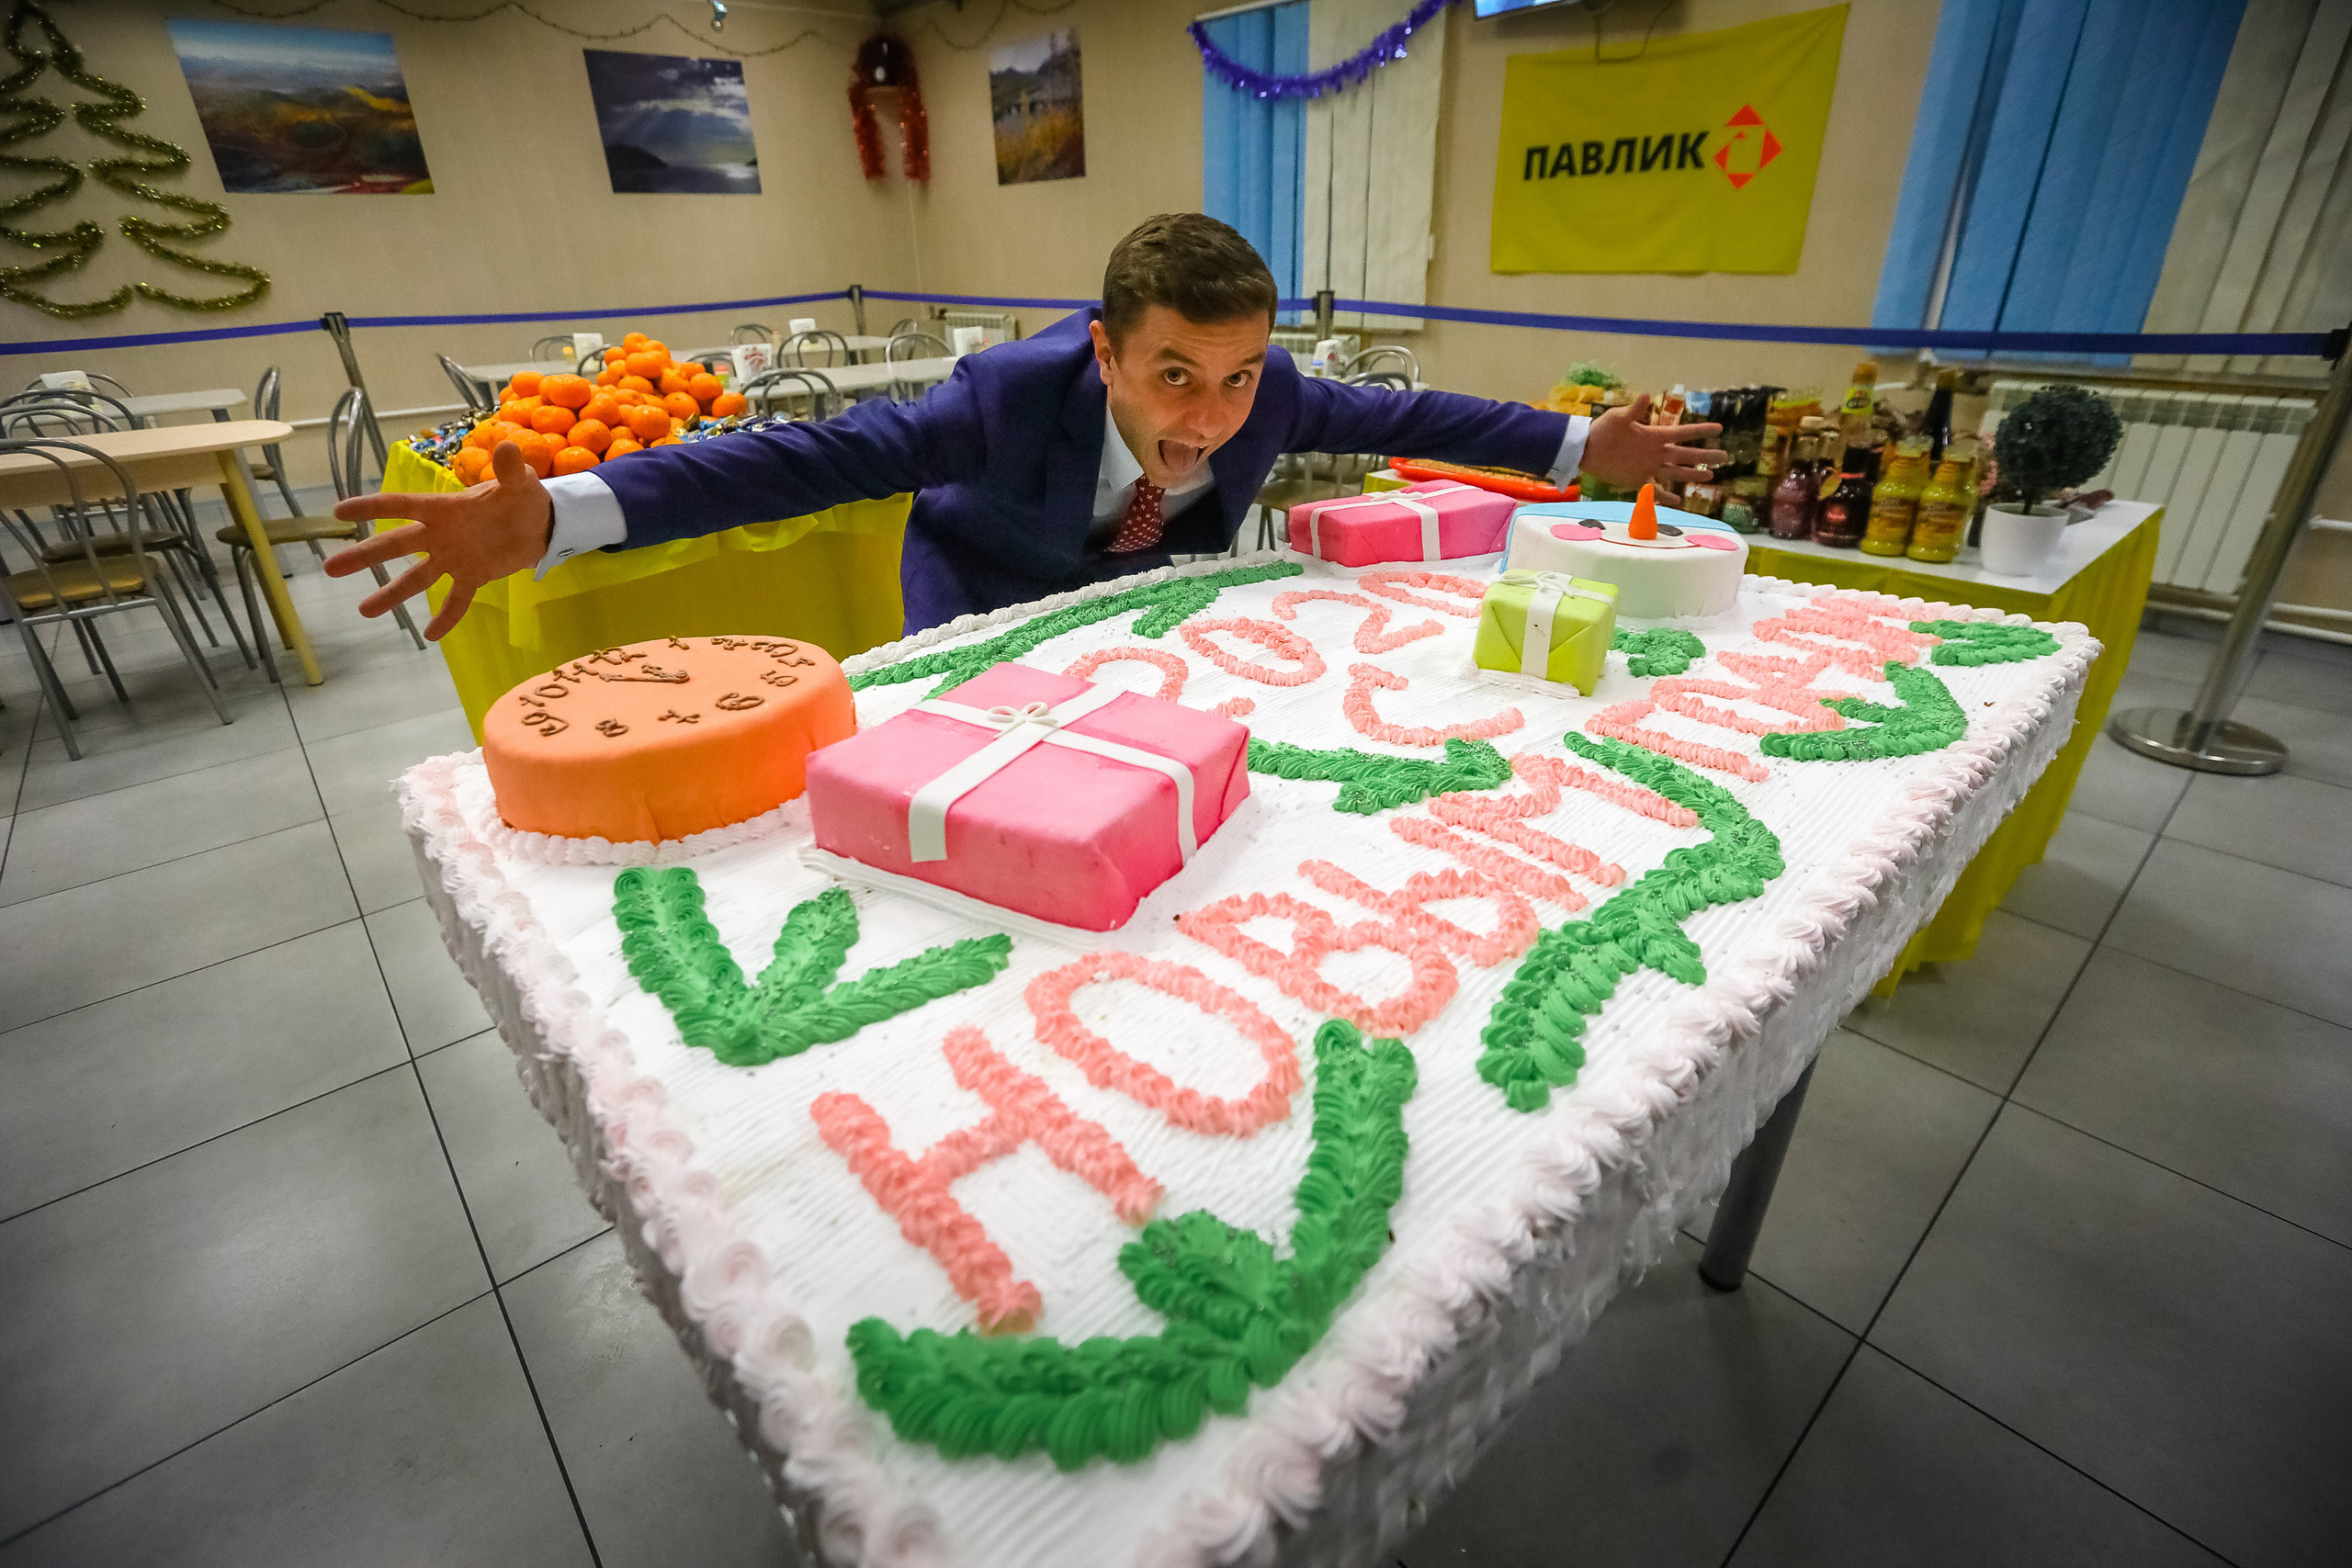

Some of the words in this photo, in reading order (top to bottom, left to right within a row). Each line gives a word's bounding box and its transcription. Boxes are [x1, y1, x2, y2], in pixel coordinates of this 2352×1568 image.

[1524, 131, 1709, 180] ПАВЛИК
[716, 693, 764, 710] 6
[1343, 662, 1525, 746] С
[522, 710, 569, 737] 9
[595, 718, 628, 737] 8
[810, 751, 1698, 1334] НОВЫМ
[1585, 597, 1944, 783] ГОДОМ
